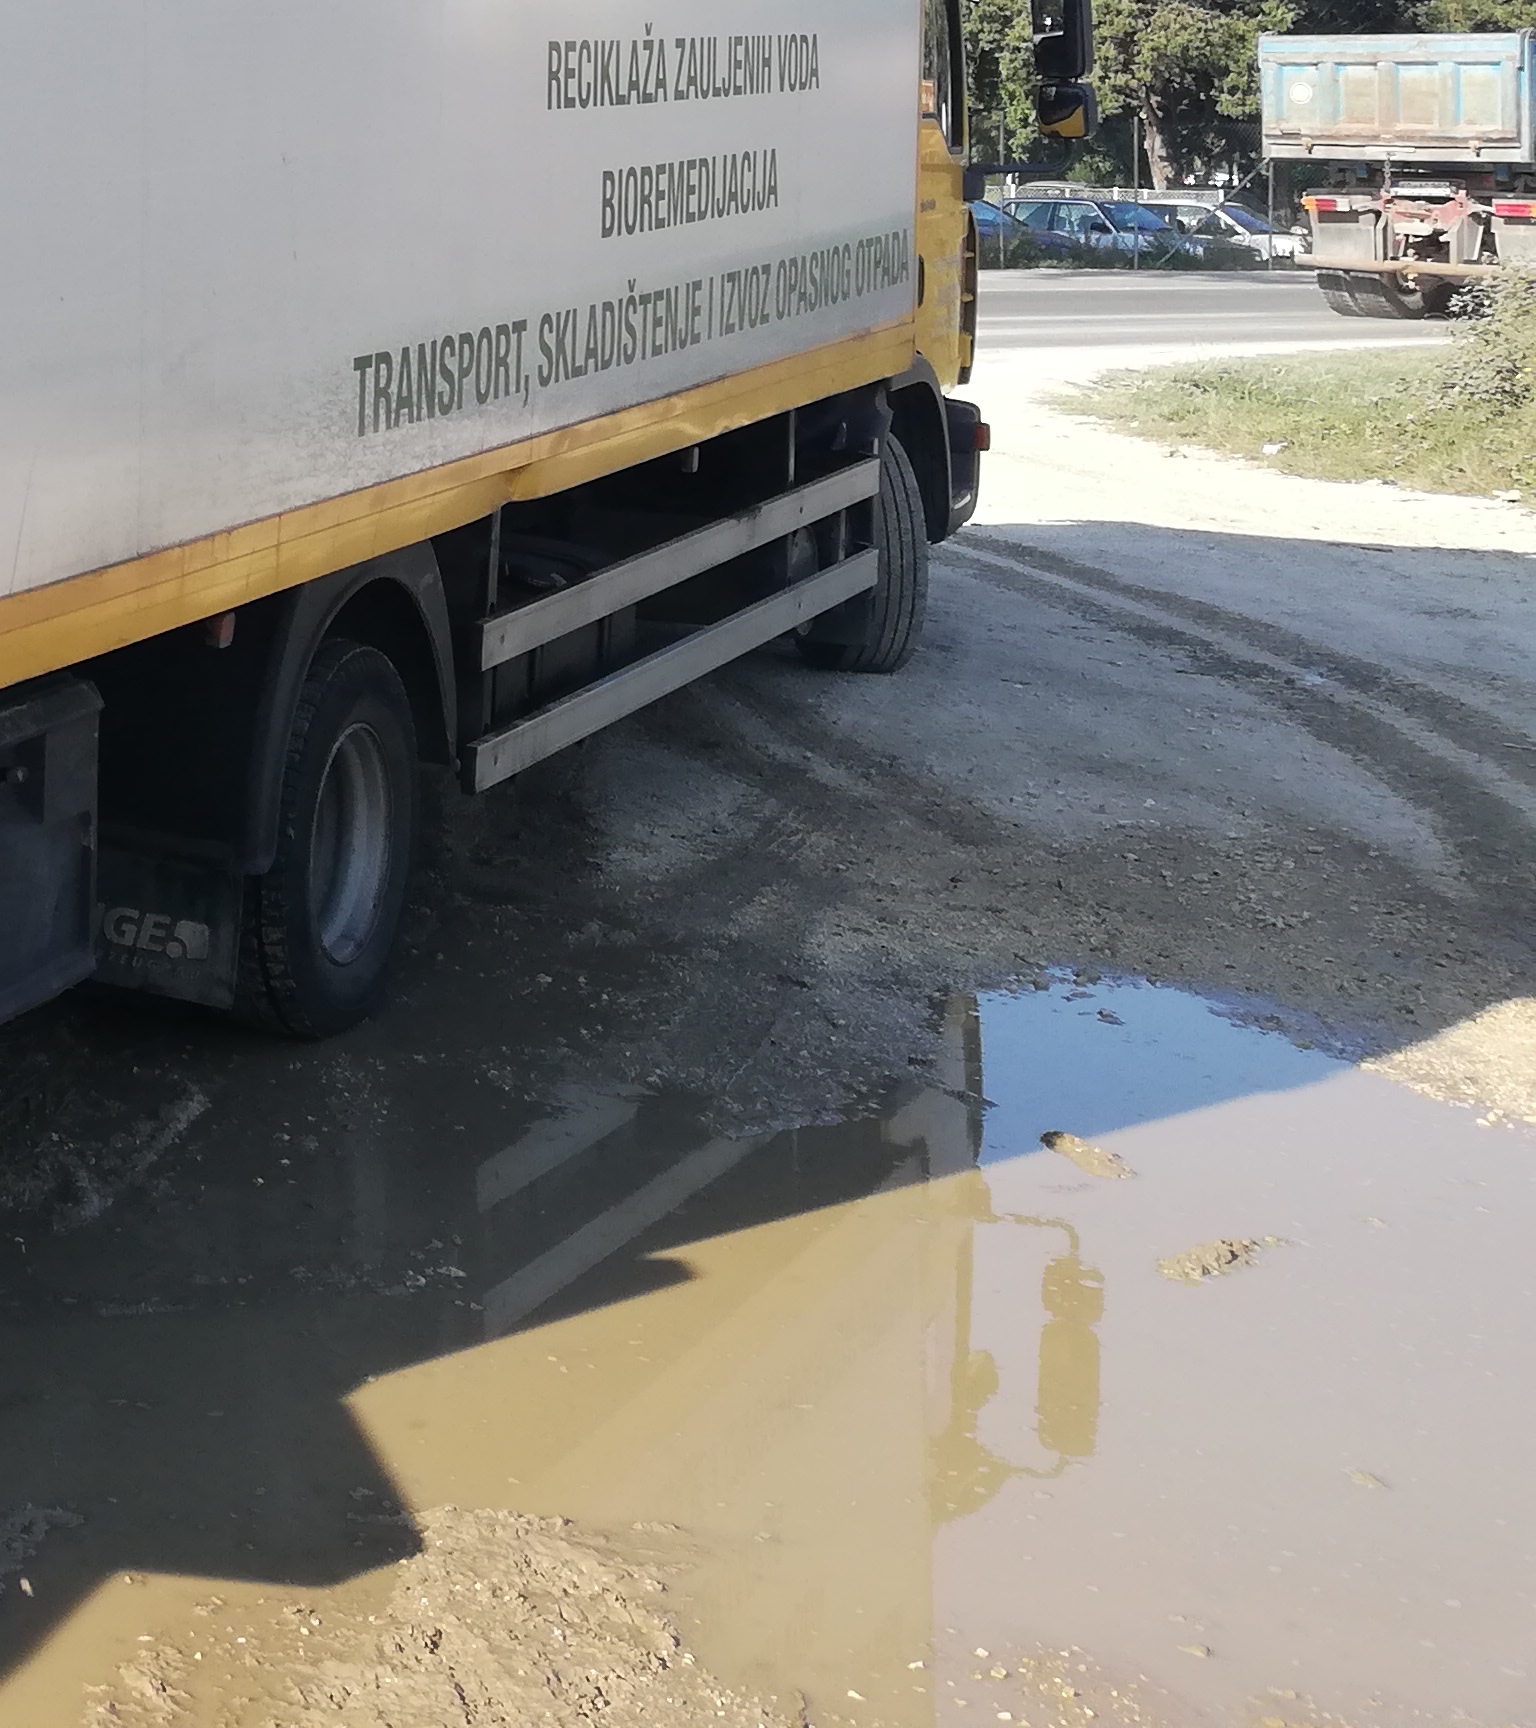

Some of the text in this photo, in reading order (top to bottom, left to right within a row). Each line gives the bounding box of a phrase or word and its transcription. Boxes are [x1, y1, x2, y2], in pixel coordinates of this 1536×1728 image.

[547, 22, 820, 110] RECIKLAŽA ZAULJENIH VODA
[601, 148, 779, 238] BIOREMEDIJACIJA
[353, 318, 529, 438] TRANSPORT,
[537, 278, 702, 388] SKLADIŠTENJE
[707, 276, 715, 341] I
[719, 263, 772, 337] IZVOZ
[775, 242, 852, 321] OPASNOG
[854, 228, 911, 298] OTPADA
